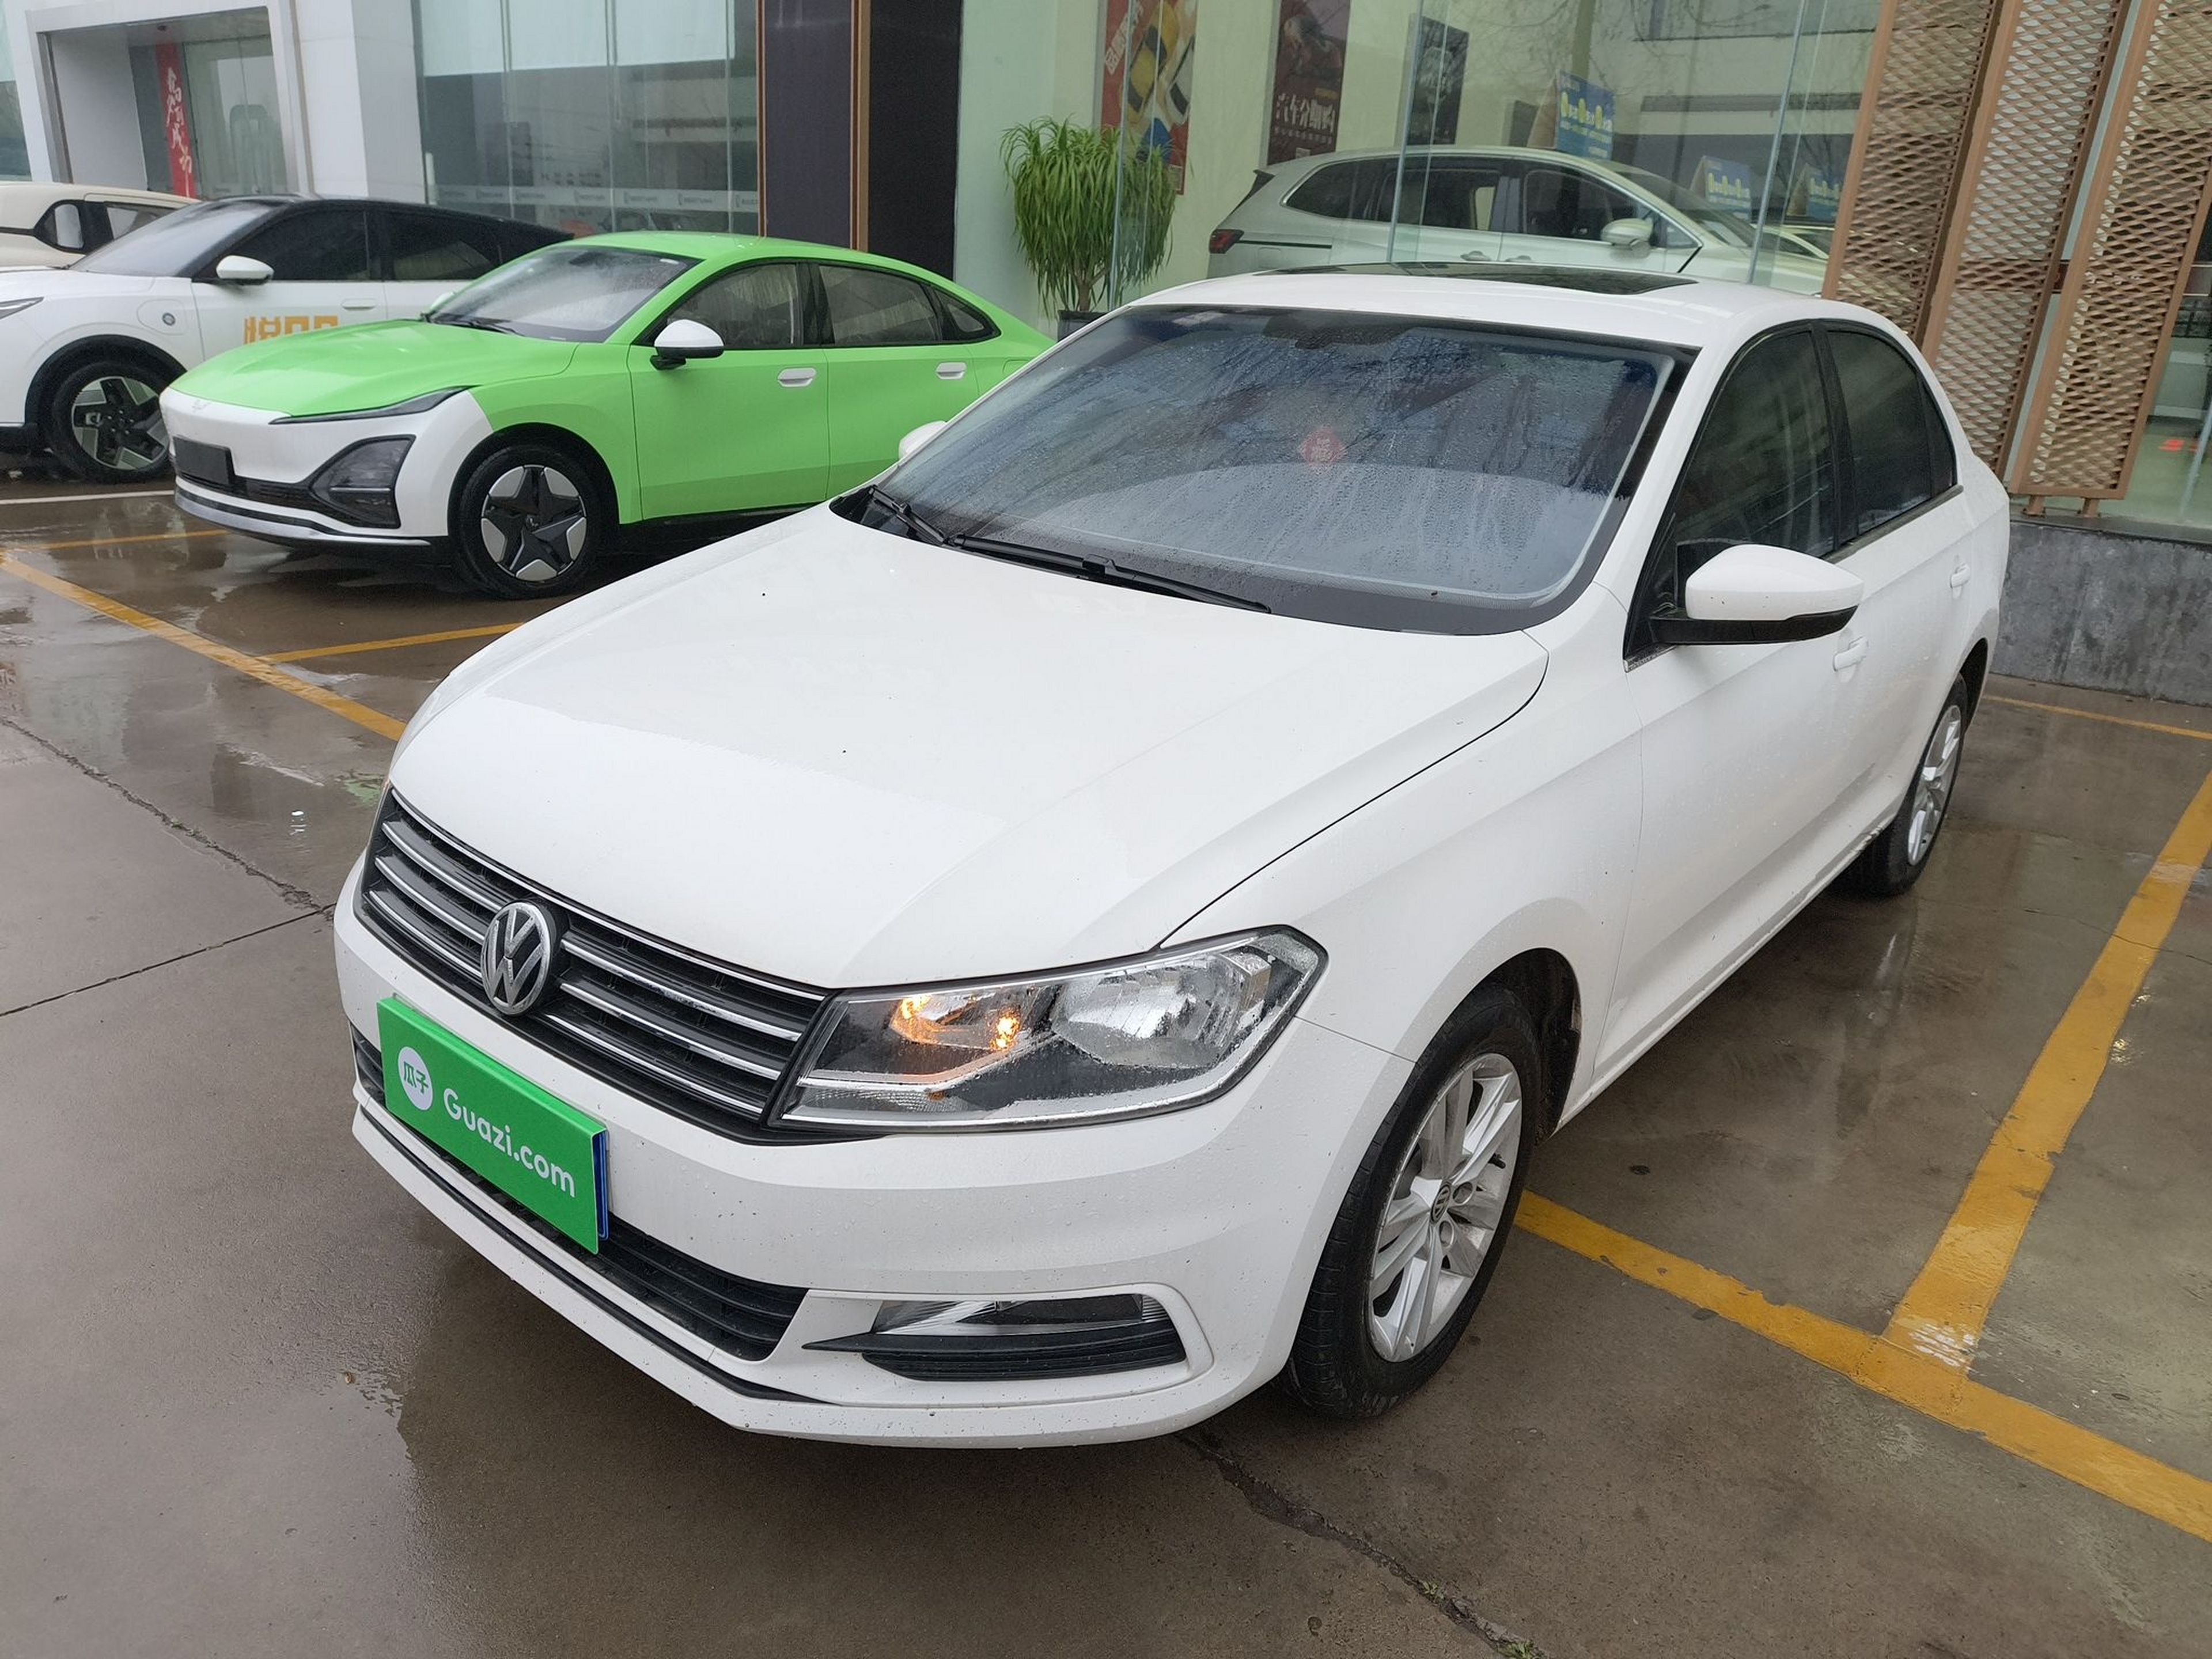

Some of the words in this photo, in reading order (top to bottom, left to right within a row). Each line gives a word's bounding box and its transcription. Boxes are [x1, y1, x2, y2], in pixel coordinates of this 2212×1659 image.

[484, 904, 548, 1012] VW
[403, 1061, 429, 1094] 瓜子
[444, 1088, 575, 1198] Guazi.com
